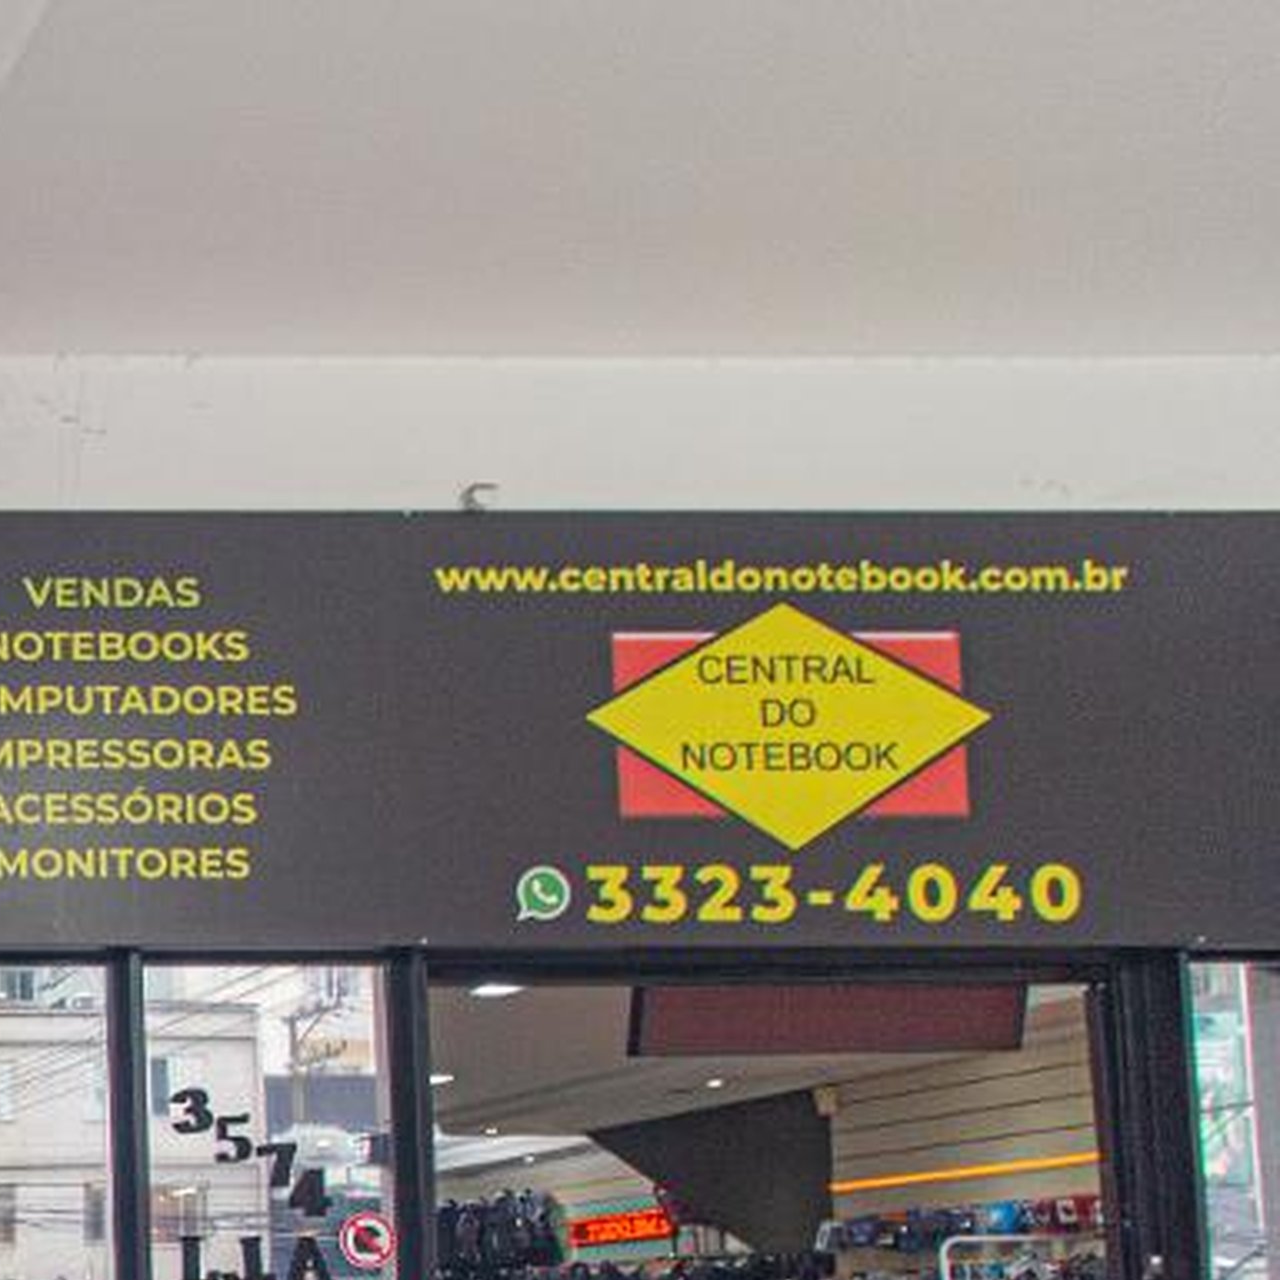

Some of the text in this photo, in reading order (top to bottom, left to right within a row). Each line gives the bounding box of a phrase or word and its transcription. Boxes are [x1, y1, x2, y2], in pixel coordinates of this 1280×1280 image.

[23, 577, 201, 608] VENDAS
[435, 560, 1128, 594] www.centraldonotebook.com.br
[696, 653, 876, 685] CENTRAL
[760, 698, 816, 728] DO
[680, 742, 901, 773] NOTEBOOK
[585, 862, 1083, 924] 3323-4040
[170, 1088, 333, 1216] 3574
